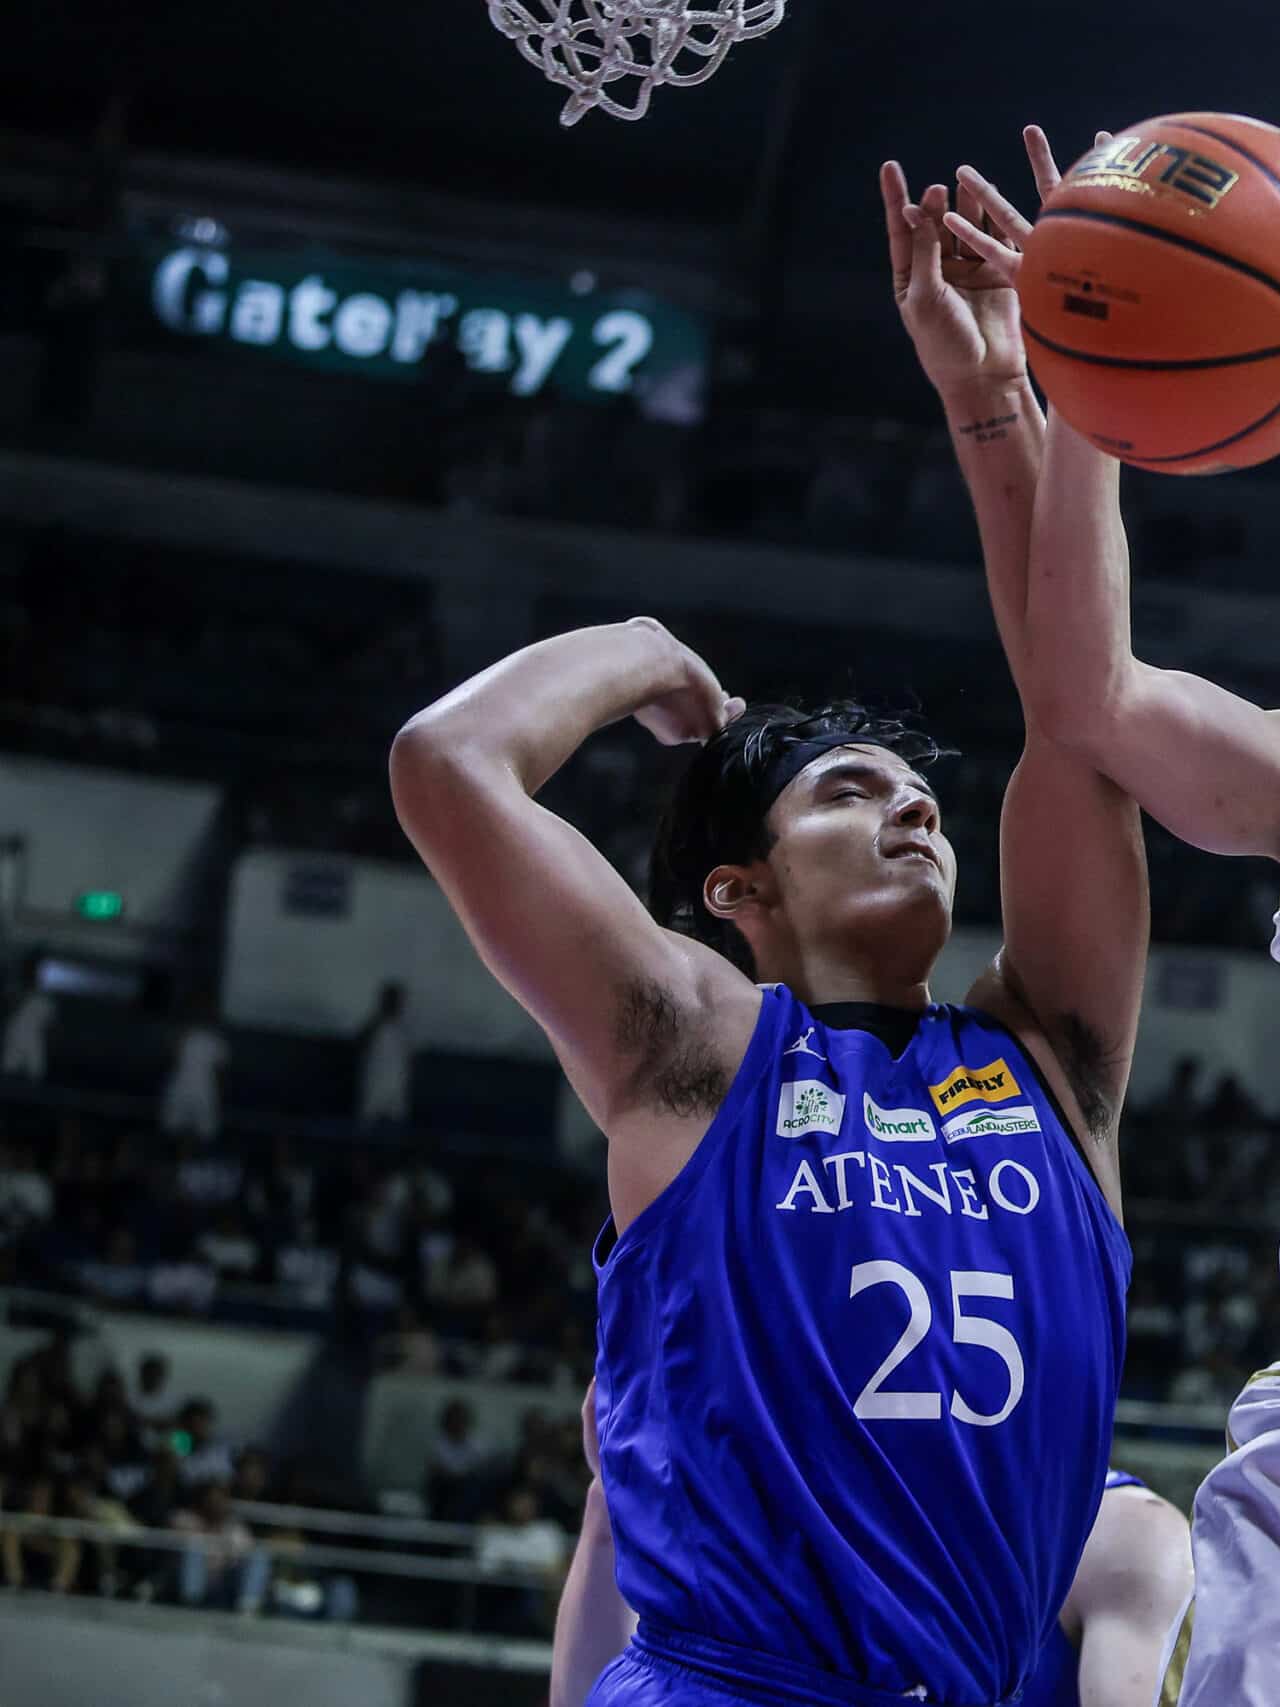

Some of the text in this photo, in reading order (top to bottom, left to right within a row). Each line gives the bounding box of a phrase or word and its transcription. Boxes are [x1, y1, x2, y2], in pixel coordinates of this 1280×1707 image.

[588, 309, 653, 391] 2
[939, 1072, 1005, 1104] FIREFLY
[875, 1115, 929, 1135] Smart
[775, 1151, 1040, 1220] ATENEO
[850, 1259, 1025, 1426] 25
